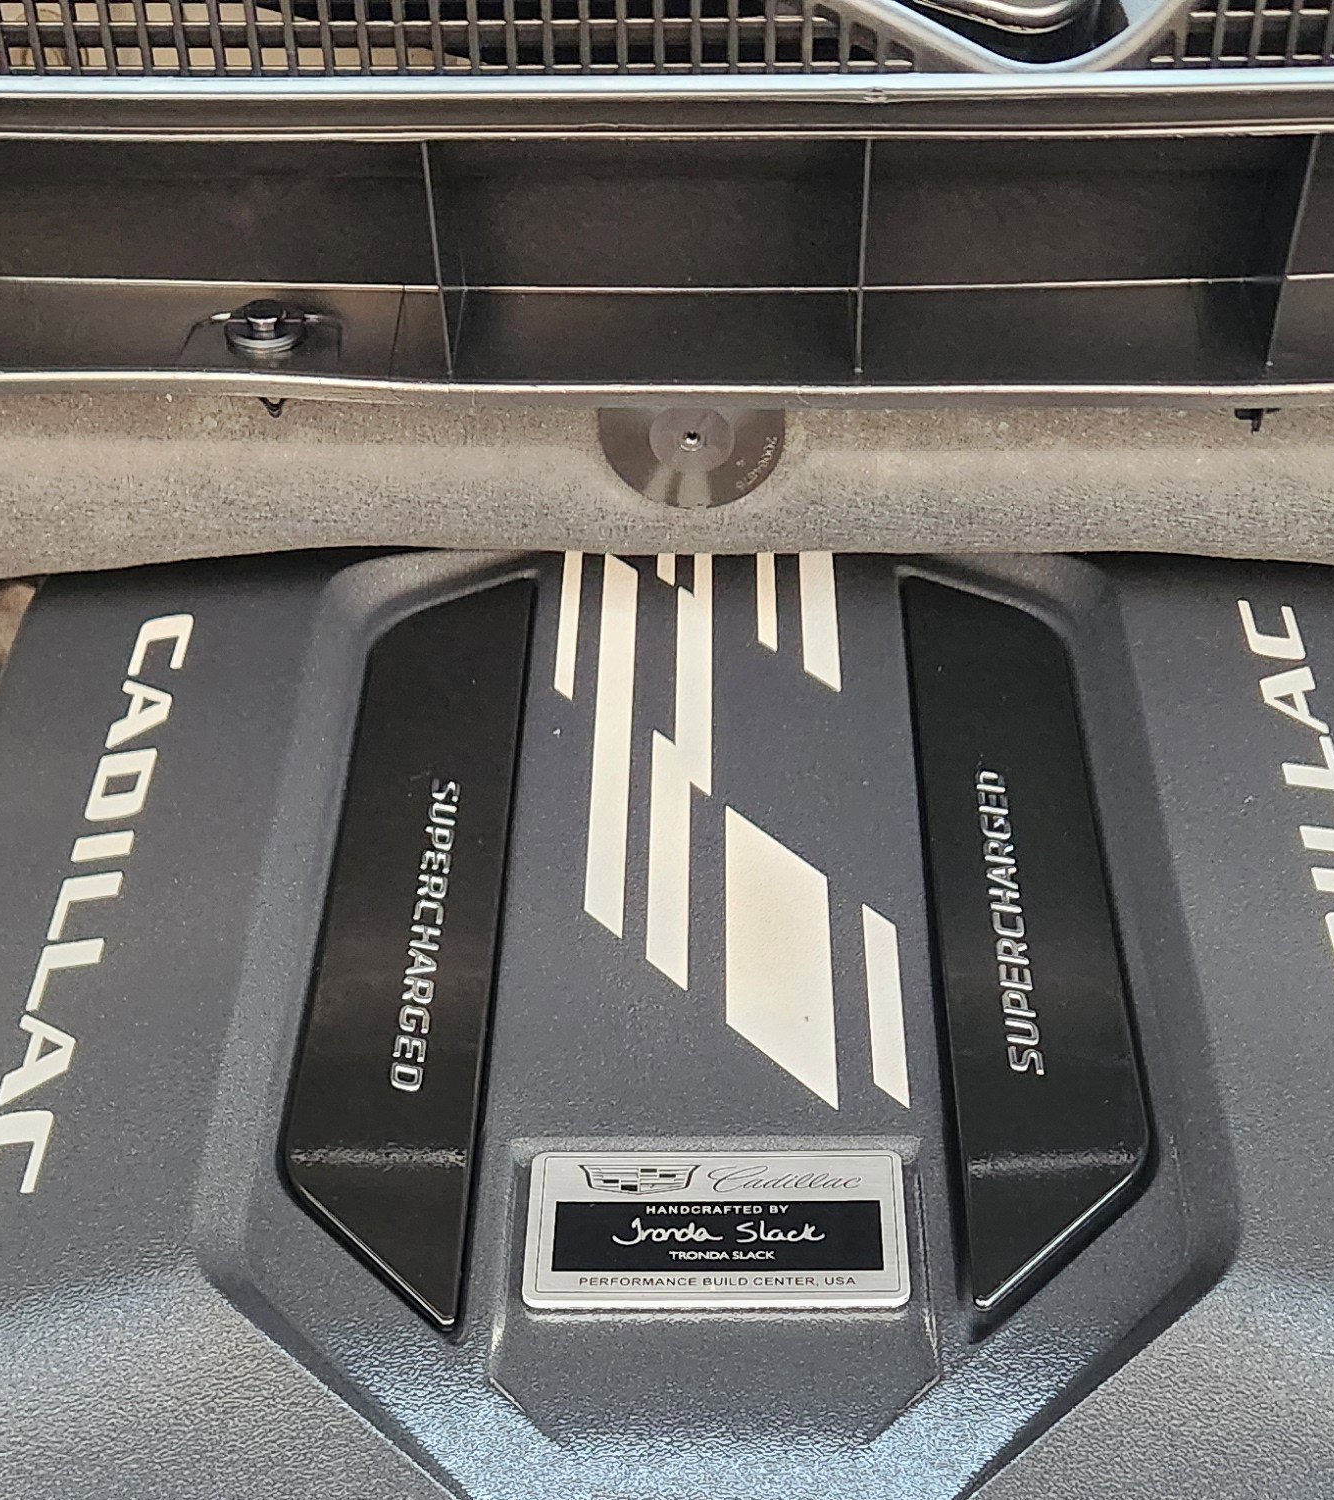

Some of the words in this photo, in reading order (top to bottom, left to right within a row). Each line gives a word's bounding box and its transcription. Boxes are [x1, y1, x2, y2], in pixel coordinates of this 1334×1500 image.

[975, 769, 1045, 1076] SUPERCHARGED
[390, 777, 461, 1093] SUPERCHARGED
[707, 1165, 862, 1193] Cadillac
[645, 1204, 763, 1215] HANDCRAFTED
[769, 1204, 790, 1215] BY
[736, 1220, 826, 1244] Slack
[669, 1250, 730, 1260] TRONDA
[731, 1250, 776, 1260] SLACK
[578, 1276, 698, 1287] PERFORMANCE
[702, 1276, 749, 1287] BUILD
[753, 1276, 819, 1287] CENTER,
[824, 1276, 857, 1286] USA
